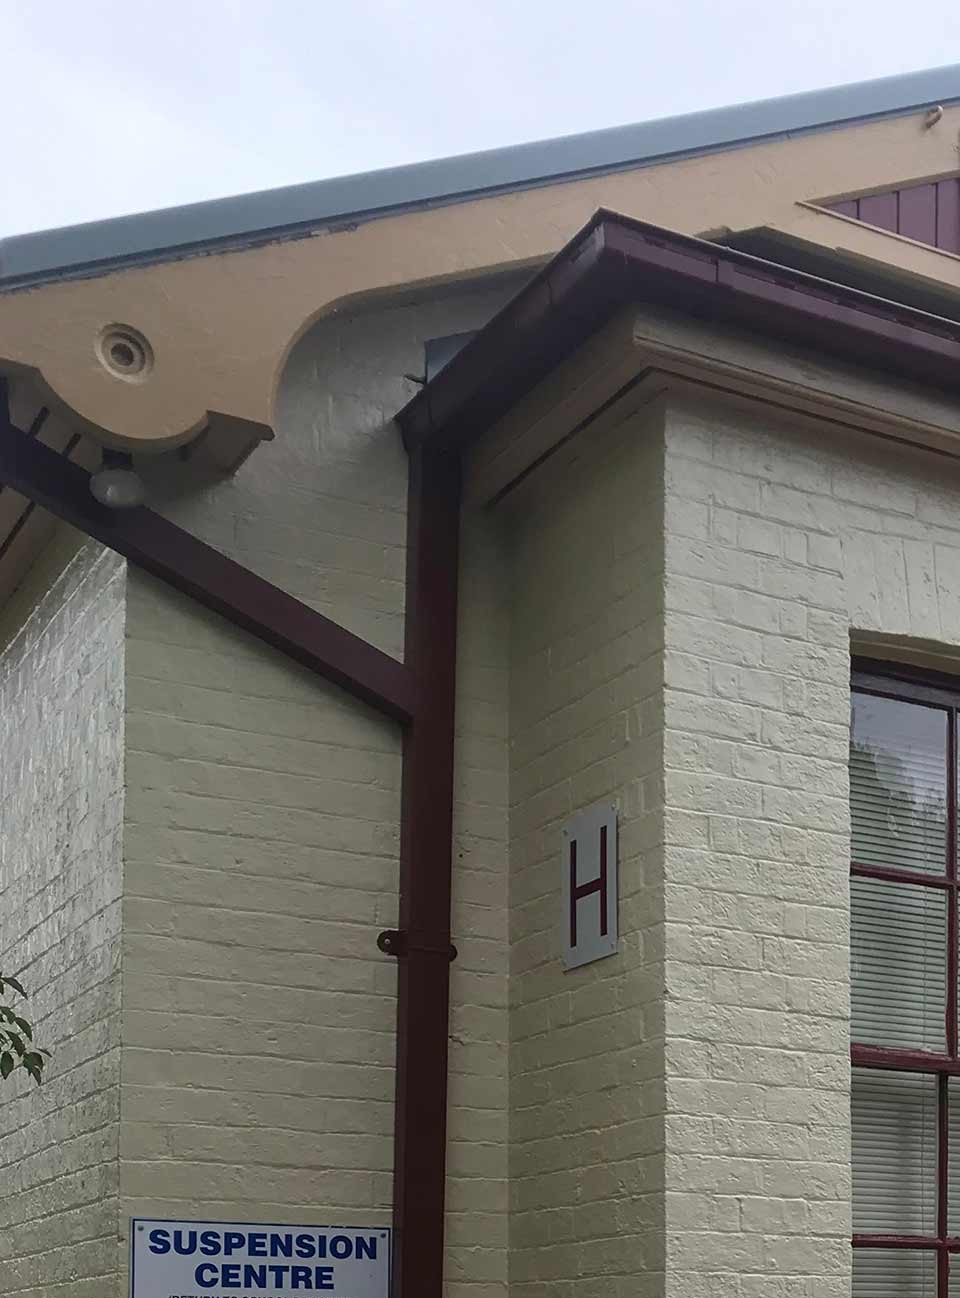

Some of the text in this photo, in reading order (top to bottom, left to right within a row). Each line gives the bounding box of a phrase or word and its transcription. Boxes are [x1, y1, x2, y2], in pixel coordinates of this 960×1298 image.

[570, 825, 607, 948] H
[149, 1229, 377, 1260] SUSPENSION
[194, 1263, 335, 1290] CENTRE
